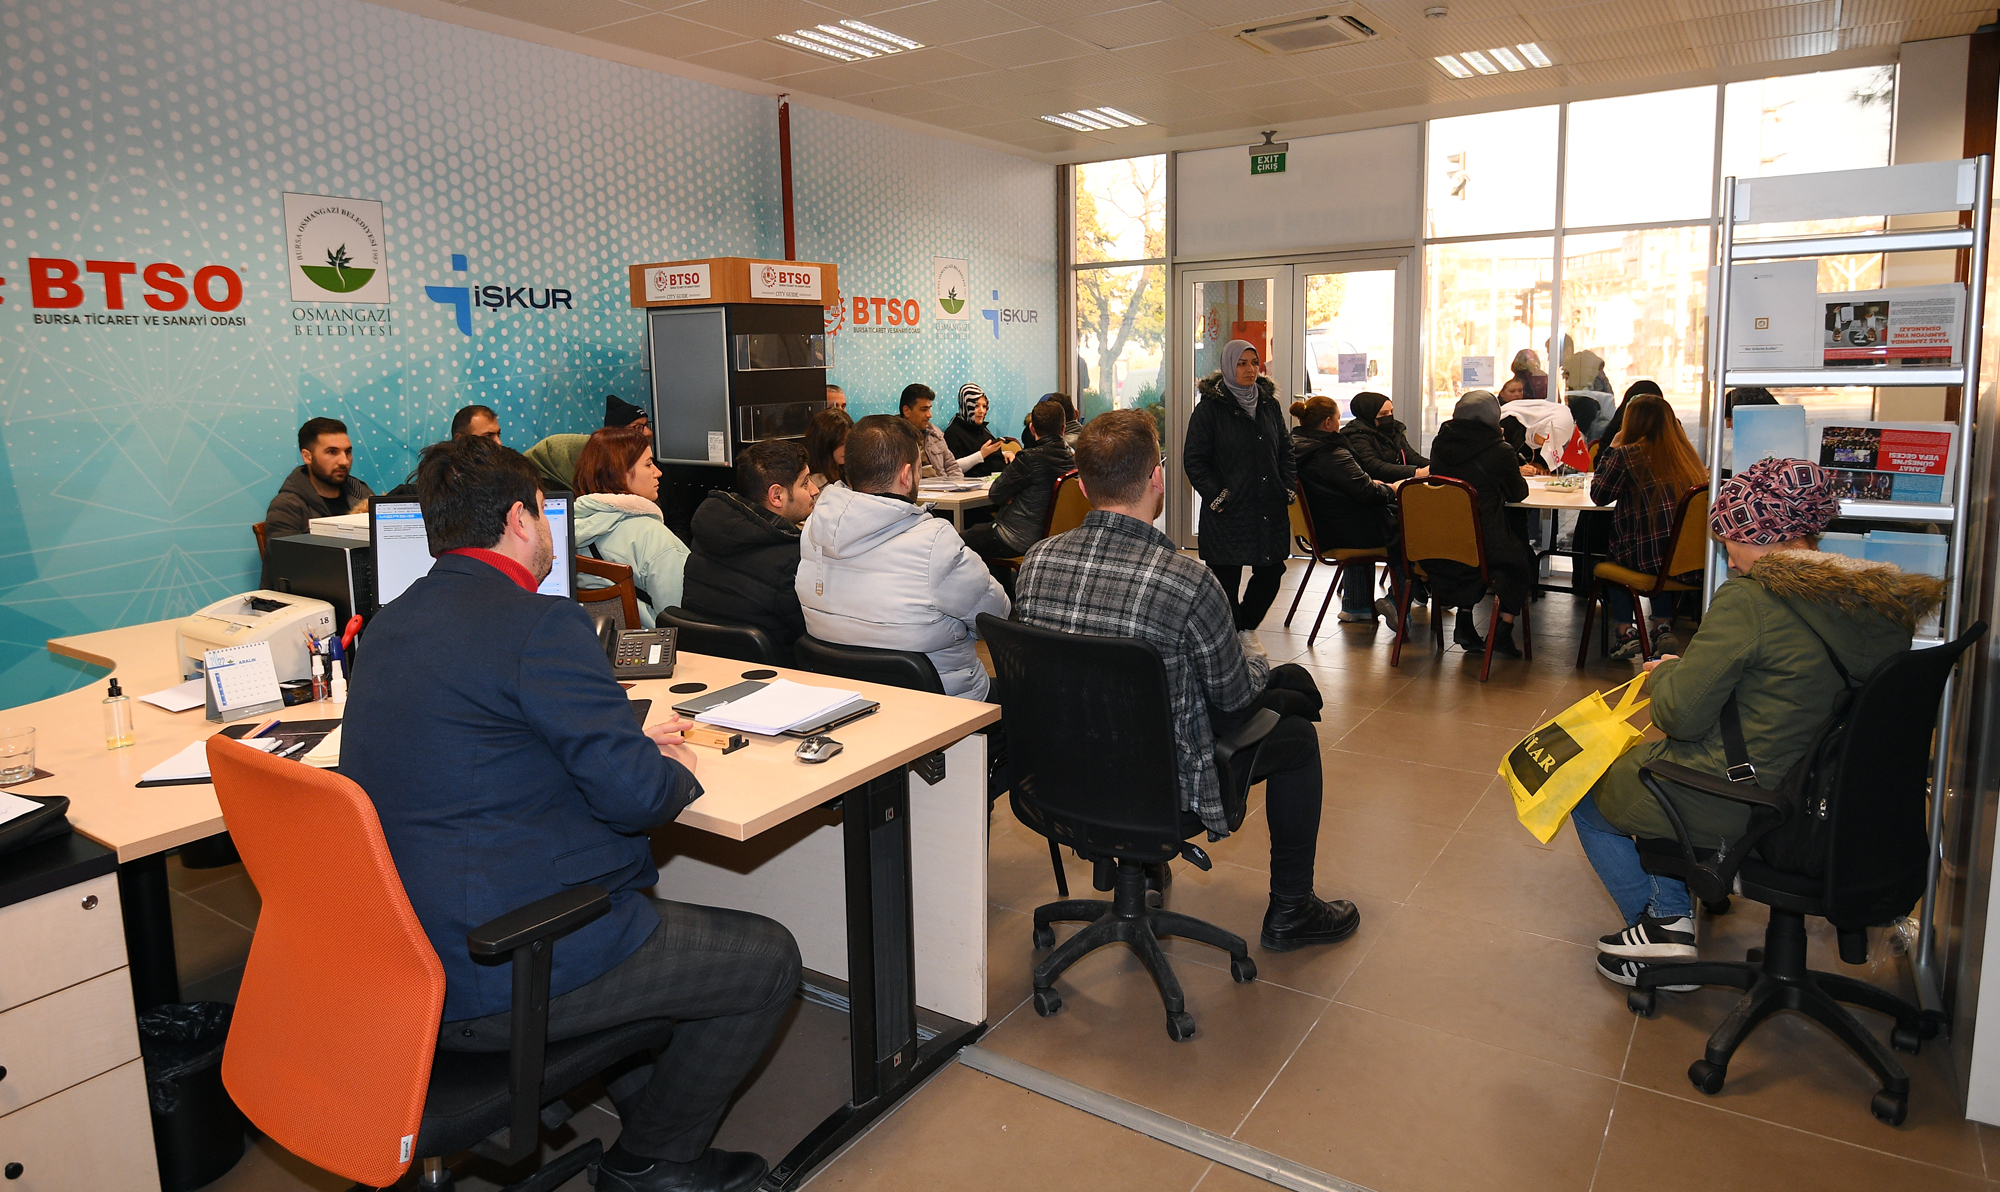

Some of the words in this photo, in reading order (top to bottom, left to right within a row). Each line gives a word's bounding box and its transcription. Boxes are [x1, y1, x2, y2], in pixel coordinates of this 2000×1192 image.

[1257, 154, 1279, 164] EXIT
[1257, 163, 1278, 173] ÇIKIŞ
[298, 206, 340, 232] OSMANGAZİ
[341, 208, 378, 247] BELEDİYESİ
[294, 234, 304, 261] BURSA
[28, 257, 244, 313] BTSO
[669, 272, 700, 286] BTSO
[778, 271, 811, 285] BTSO
[292, 307, 391, 322] OSMANGAZİ
[852, 296, 920, 326] BTSO
[33, 313, 82, 325] BURSA
[84, 312, 140, 326] TİCARET
[143, 315, 160, 326] VE
[163, 314, 207, 326] SANAYİ
[210, 316, 246, 326] ODASI
[295, 324, 393, 337] BELEDİYESİ
[319, 616, 330, 625] 18
